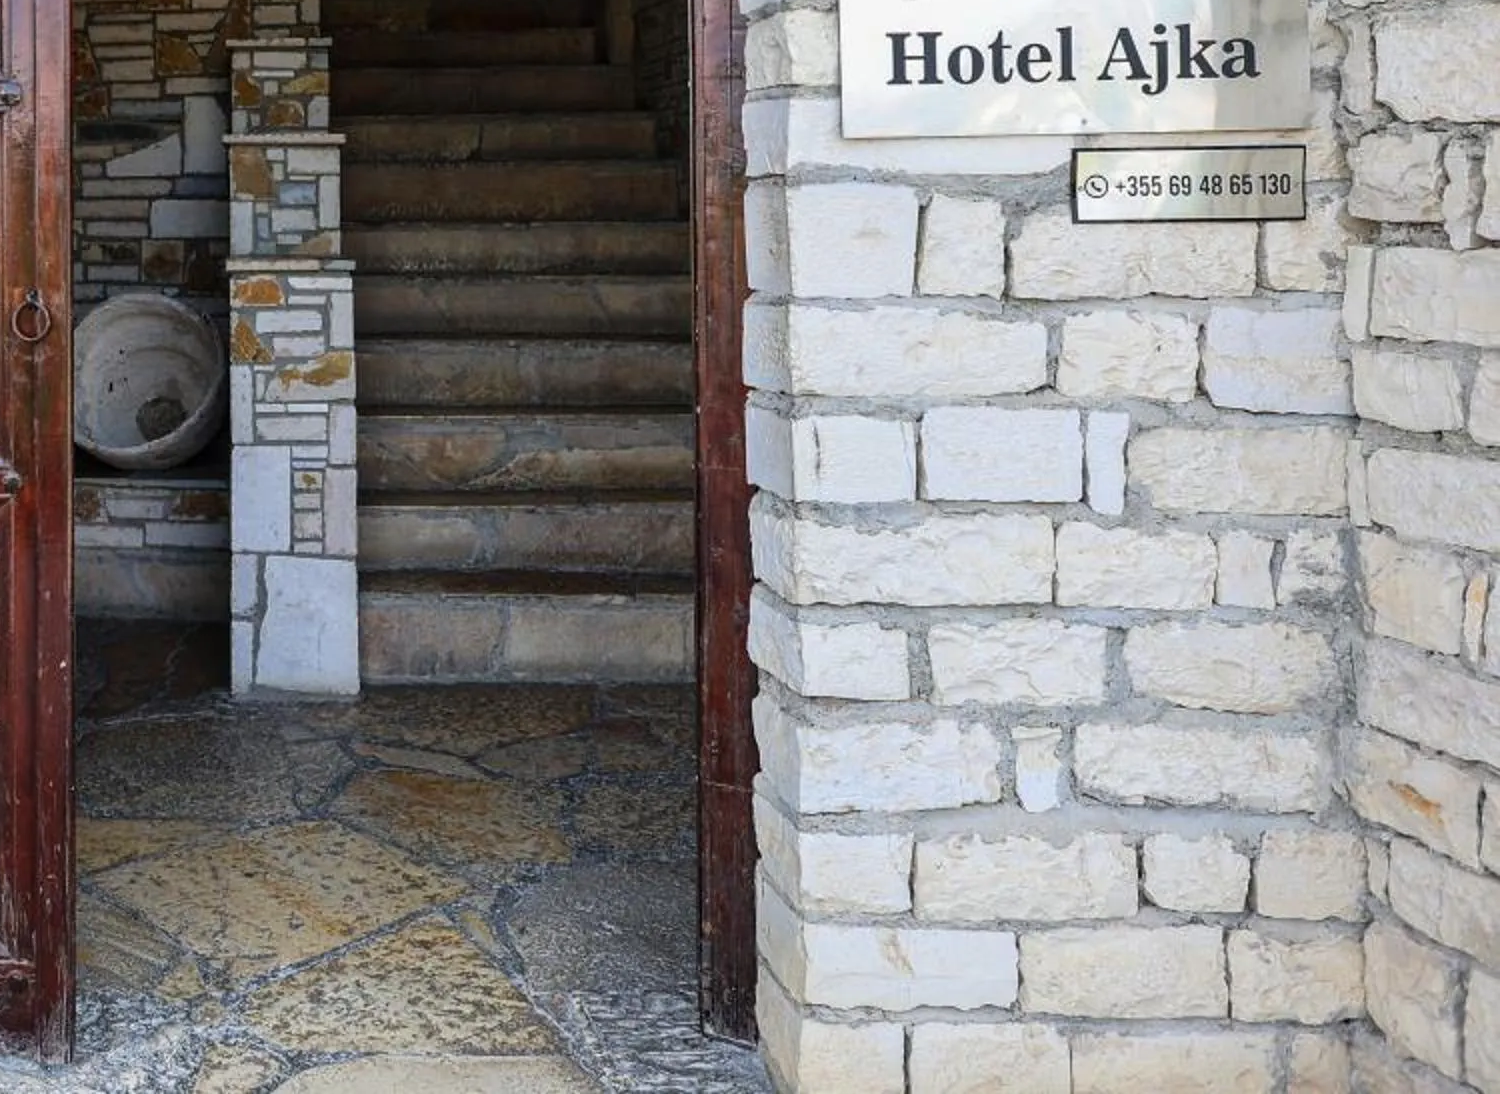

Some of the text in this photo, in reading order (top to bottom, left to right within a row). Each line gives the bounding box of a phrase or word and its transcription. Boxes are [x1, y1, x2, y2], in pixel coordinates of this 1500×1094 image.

[886, 23, 1261, 96] Hotel Ajka
[1115, 173, 1291, 197] +355 69 48 65 130
